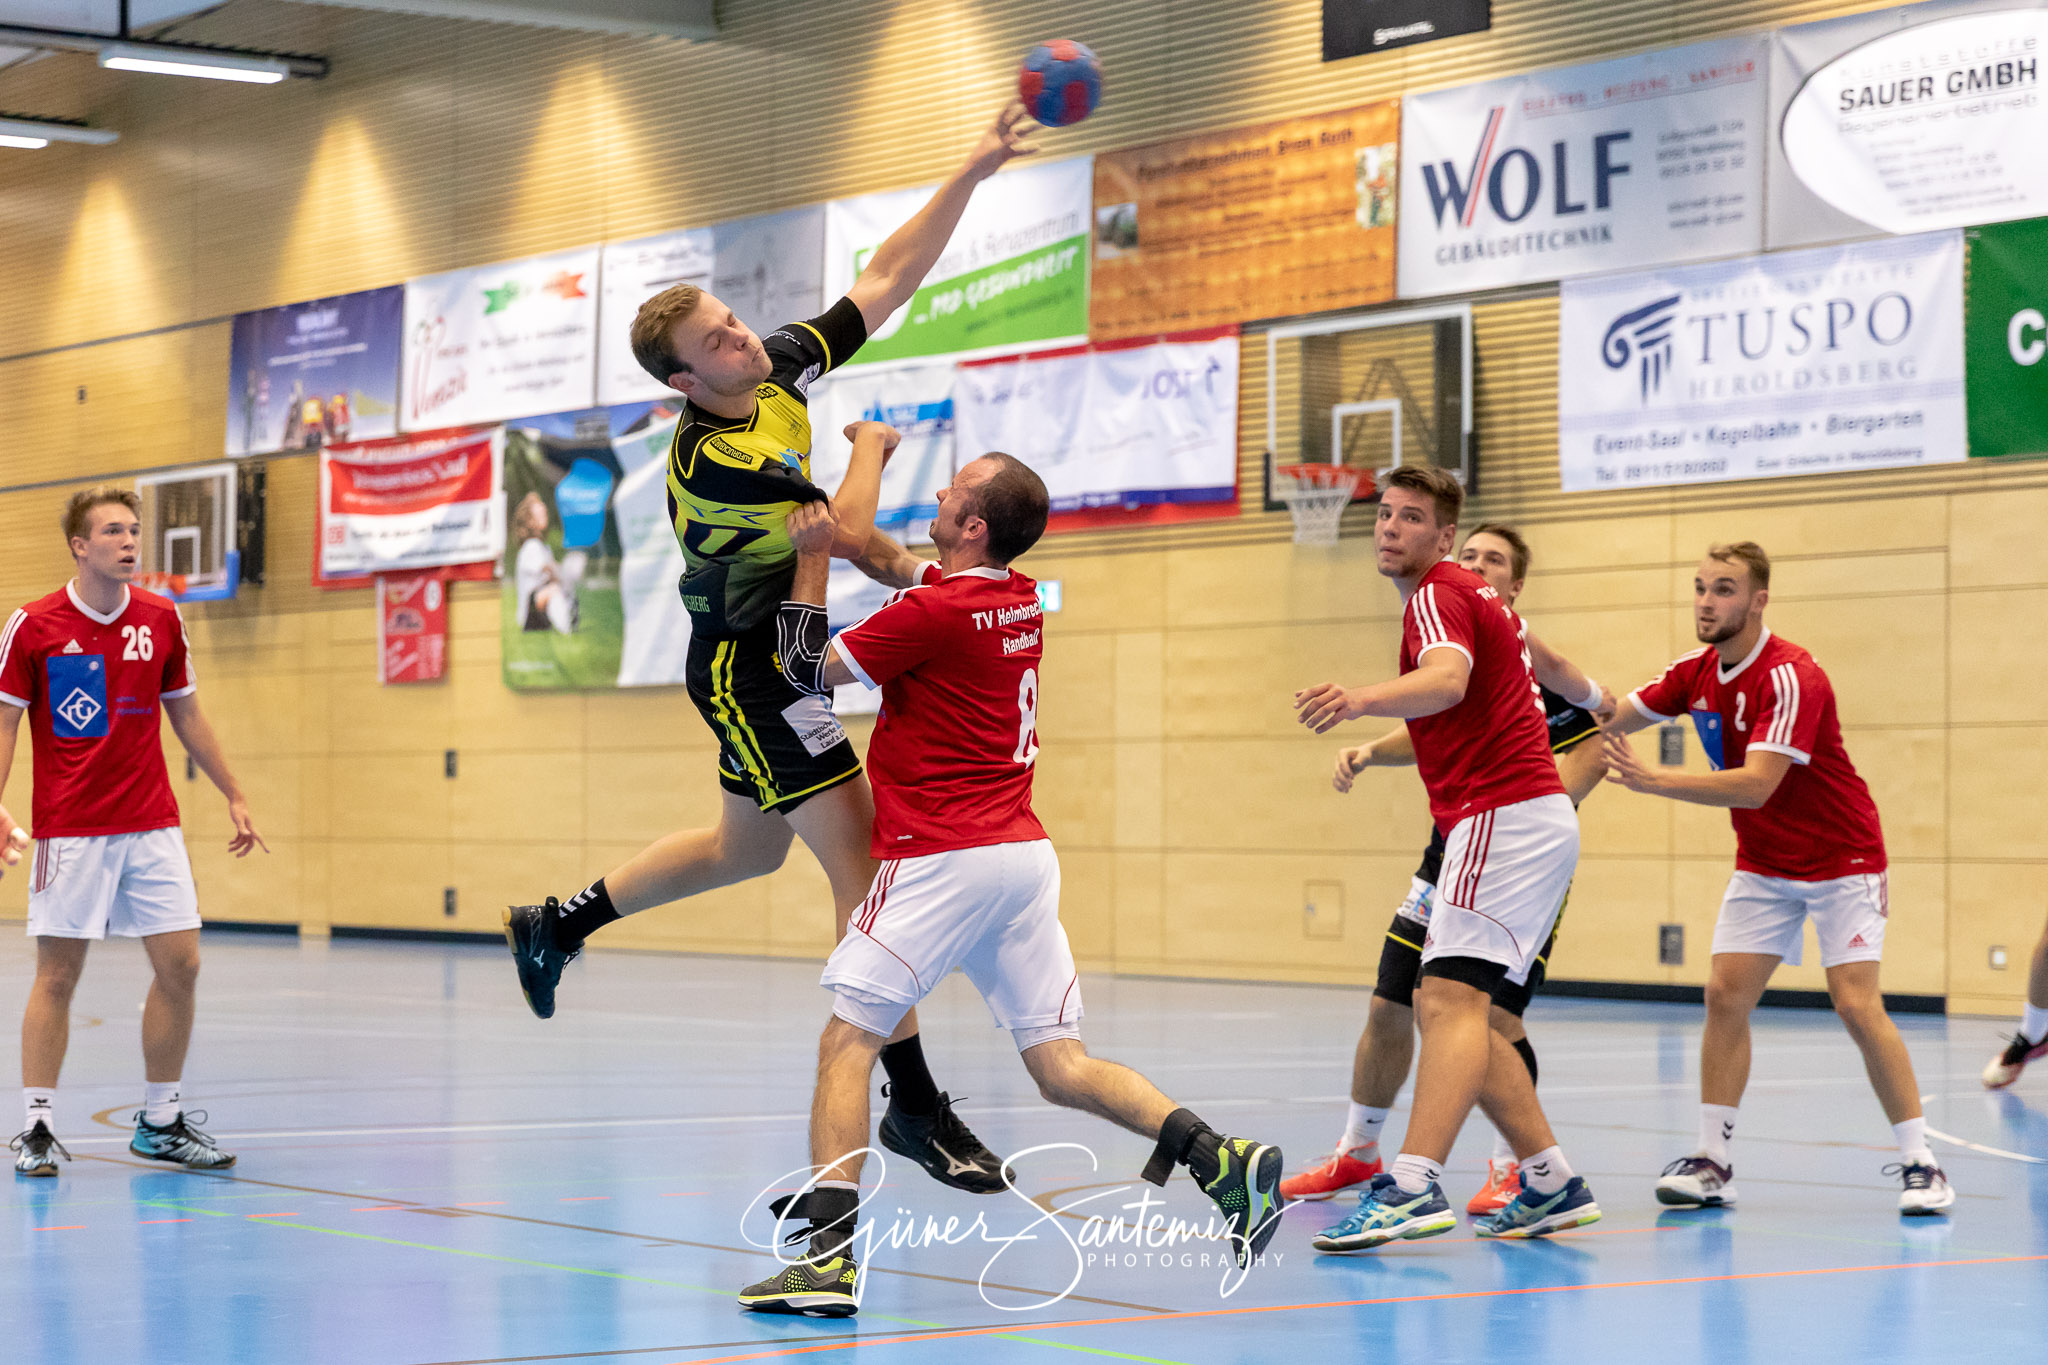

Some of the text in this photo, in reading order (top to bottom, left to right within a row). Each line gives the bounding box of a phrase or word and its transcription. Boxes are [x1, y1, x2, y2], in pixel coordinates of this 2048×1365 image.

[1838, 57, 2037, 112] SAUER GMBH
[1421, 106, 1632, 229] WOLF
[1435, 222, 1614, 267] GEBÄUDETECHNIK
[1686, 290, 1913, 366] TUSPO
[2007, 308, 2048, 367] C
[1688, 355, 1918, 400] HEROLDSBERG
[1705, 420, 1802, 449] Kegelbahn
[1824, 409, 1925, 439] Biergarten
[971, 610, 993, 631] TV
[121, 624, 154, 662] 26
[1002, 627, 1040, 656] Handball
[799, 720, 834, 743] Städtische
[1734, 691, 1747, 732] 2
[816, 726, 837, 742] Werke
[820, 735, 836, 750] Lauf
